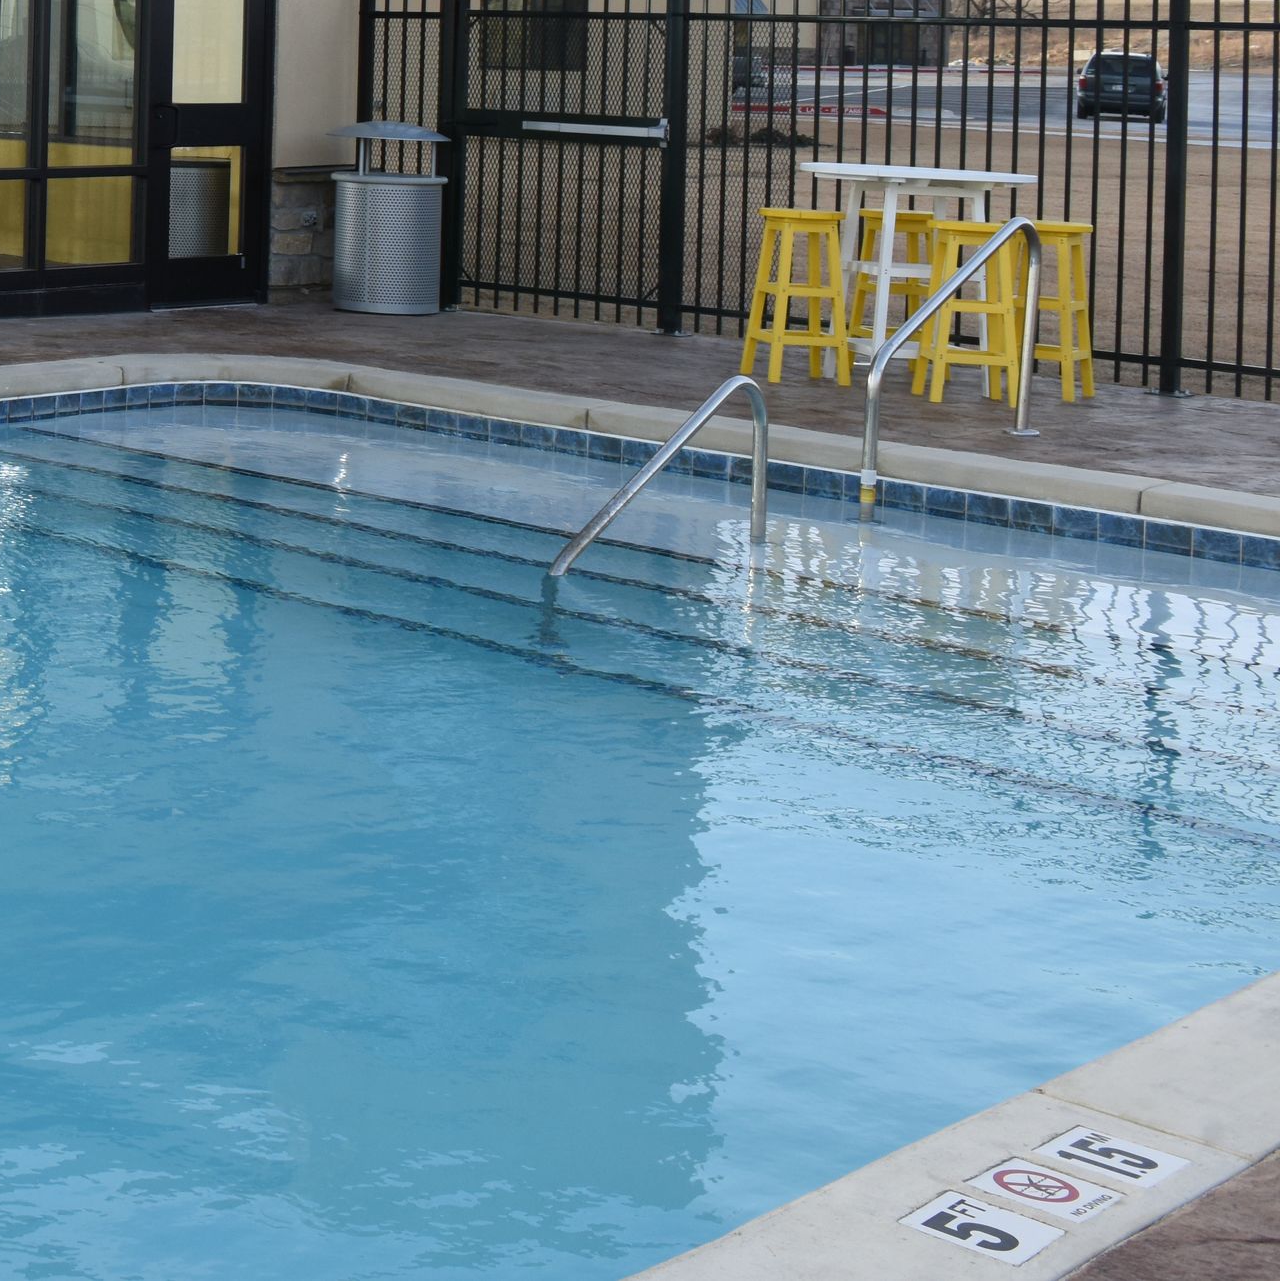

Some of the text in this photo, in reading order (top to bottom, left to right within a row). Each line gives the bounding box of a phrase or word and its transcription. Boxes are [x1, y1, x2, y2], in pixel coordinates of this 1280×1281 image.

[921, 1198, 1020, 1252] 5 FT
[1070, 1208, 1088, 1217] NO
